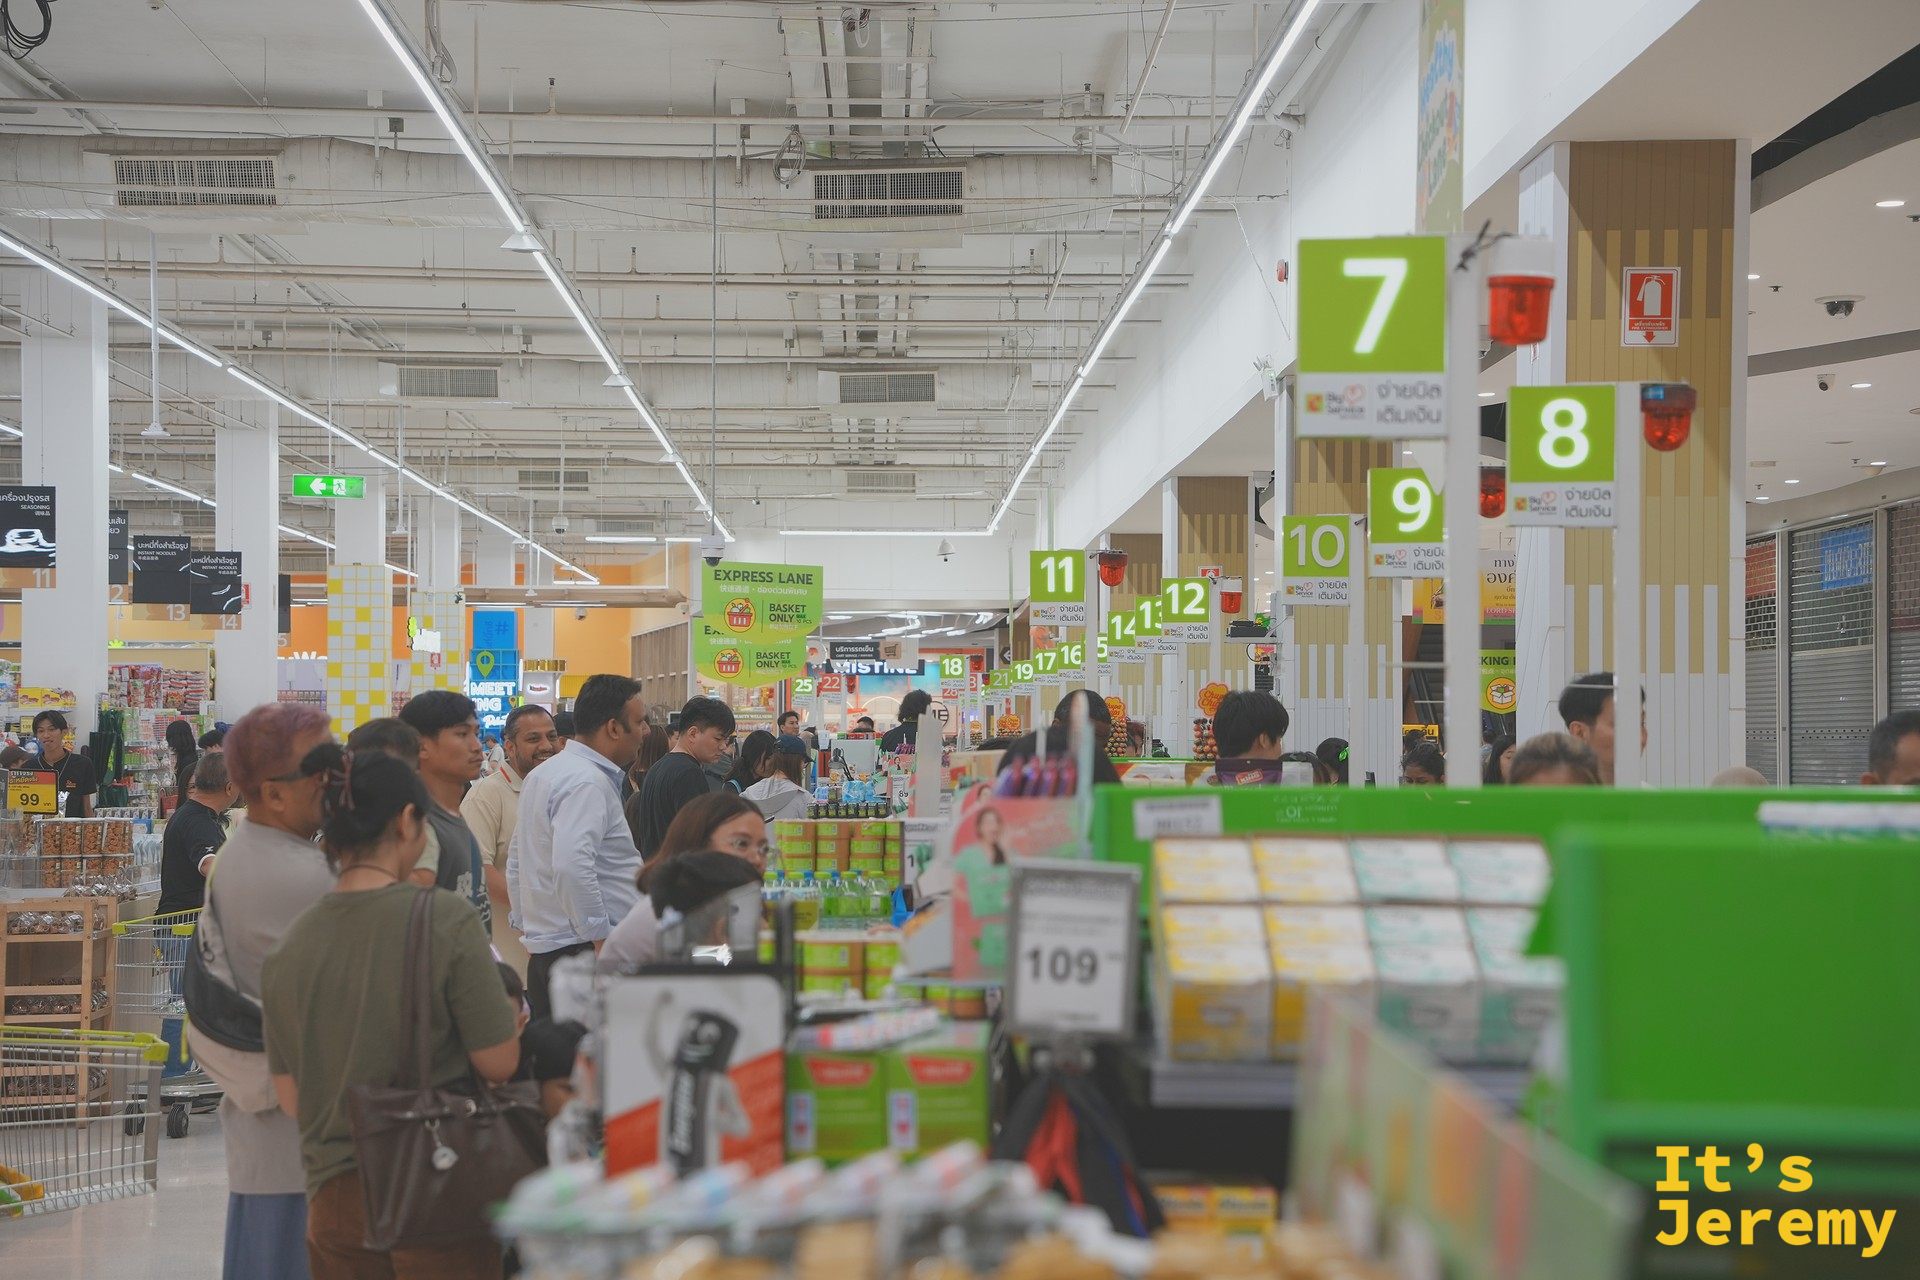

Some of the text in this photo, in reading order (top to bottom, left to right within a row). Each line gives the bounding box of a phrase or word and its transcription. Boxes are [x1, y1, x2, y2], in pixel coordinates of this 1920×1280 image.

[1343, 258, 1407, 354] 7
[1539, 398, 1589, 468] 8
[1565, 487, 1612, 500] จ่ายบิล
[1392, 478, 1432, 533] 9
[1565, 504, 1612, 517] เติมเงิน
[1290, 524, 1345, 568] 10
[33, 568, 50, 588] 11
[714, 569, 814, 585] EXPRESS LANE
[1040, 556, 1073, 593] 11
[1318, 580, 1348, 589] จ่ายบิล
[112, 584, 124, 601] 2
[1166, 583, 1206, 614] 12
[1318, 591, 1348, 600] เติมเงิน
[167, 605, 186, 621] 13
[769, 603, 806, 613] BASKET
[219, 615, 238, 629] 14
[769, 613, 794, 623] ONLY
[1111, 615, 1135, 640] 14
[278, 633, 288, 647] 5
[756, 652, 791, 660] BASKET
[1035, 652, 1057, 671] 17
[1060, 644, 1081, 665] 16
[1481, 656, 1509, 666] KING
[756, 660, 780, 668] ONLY
[942, 657, 963, 676] 18
[1014, 663, 1034, 680] 19
[795, 678, 813, 692] 25
[823, 676, 840, 689] 22
[993, 672, 1009, 686] 21
[470, 682, 515, 696] MEET
[20, 793, 40, 806] 99
[1027, 945, 1098, 985] 109
